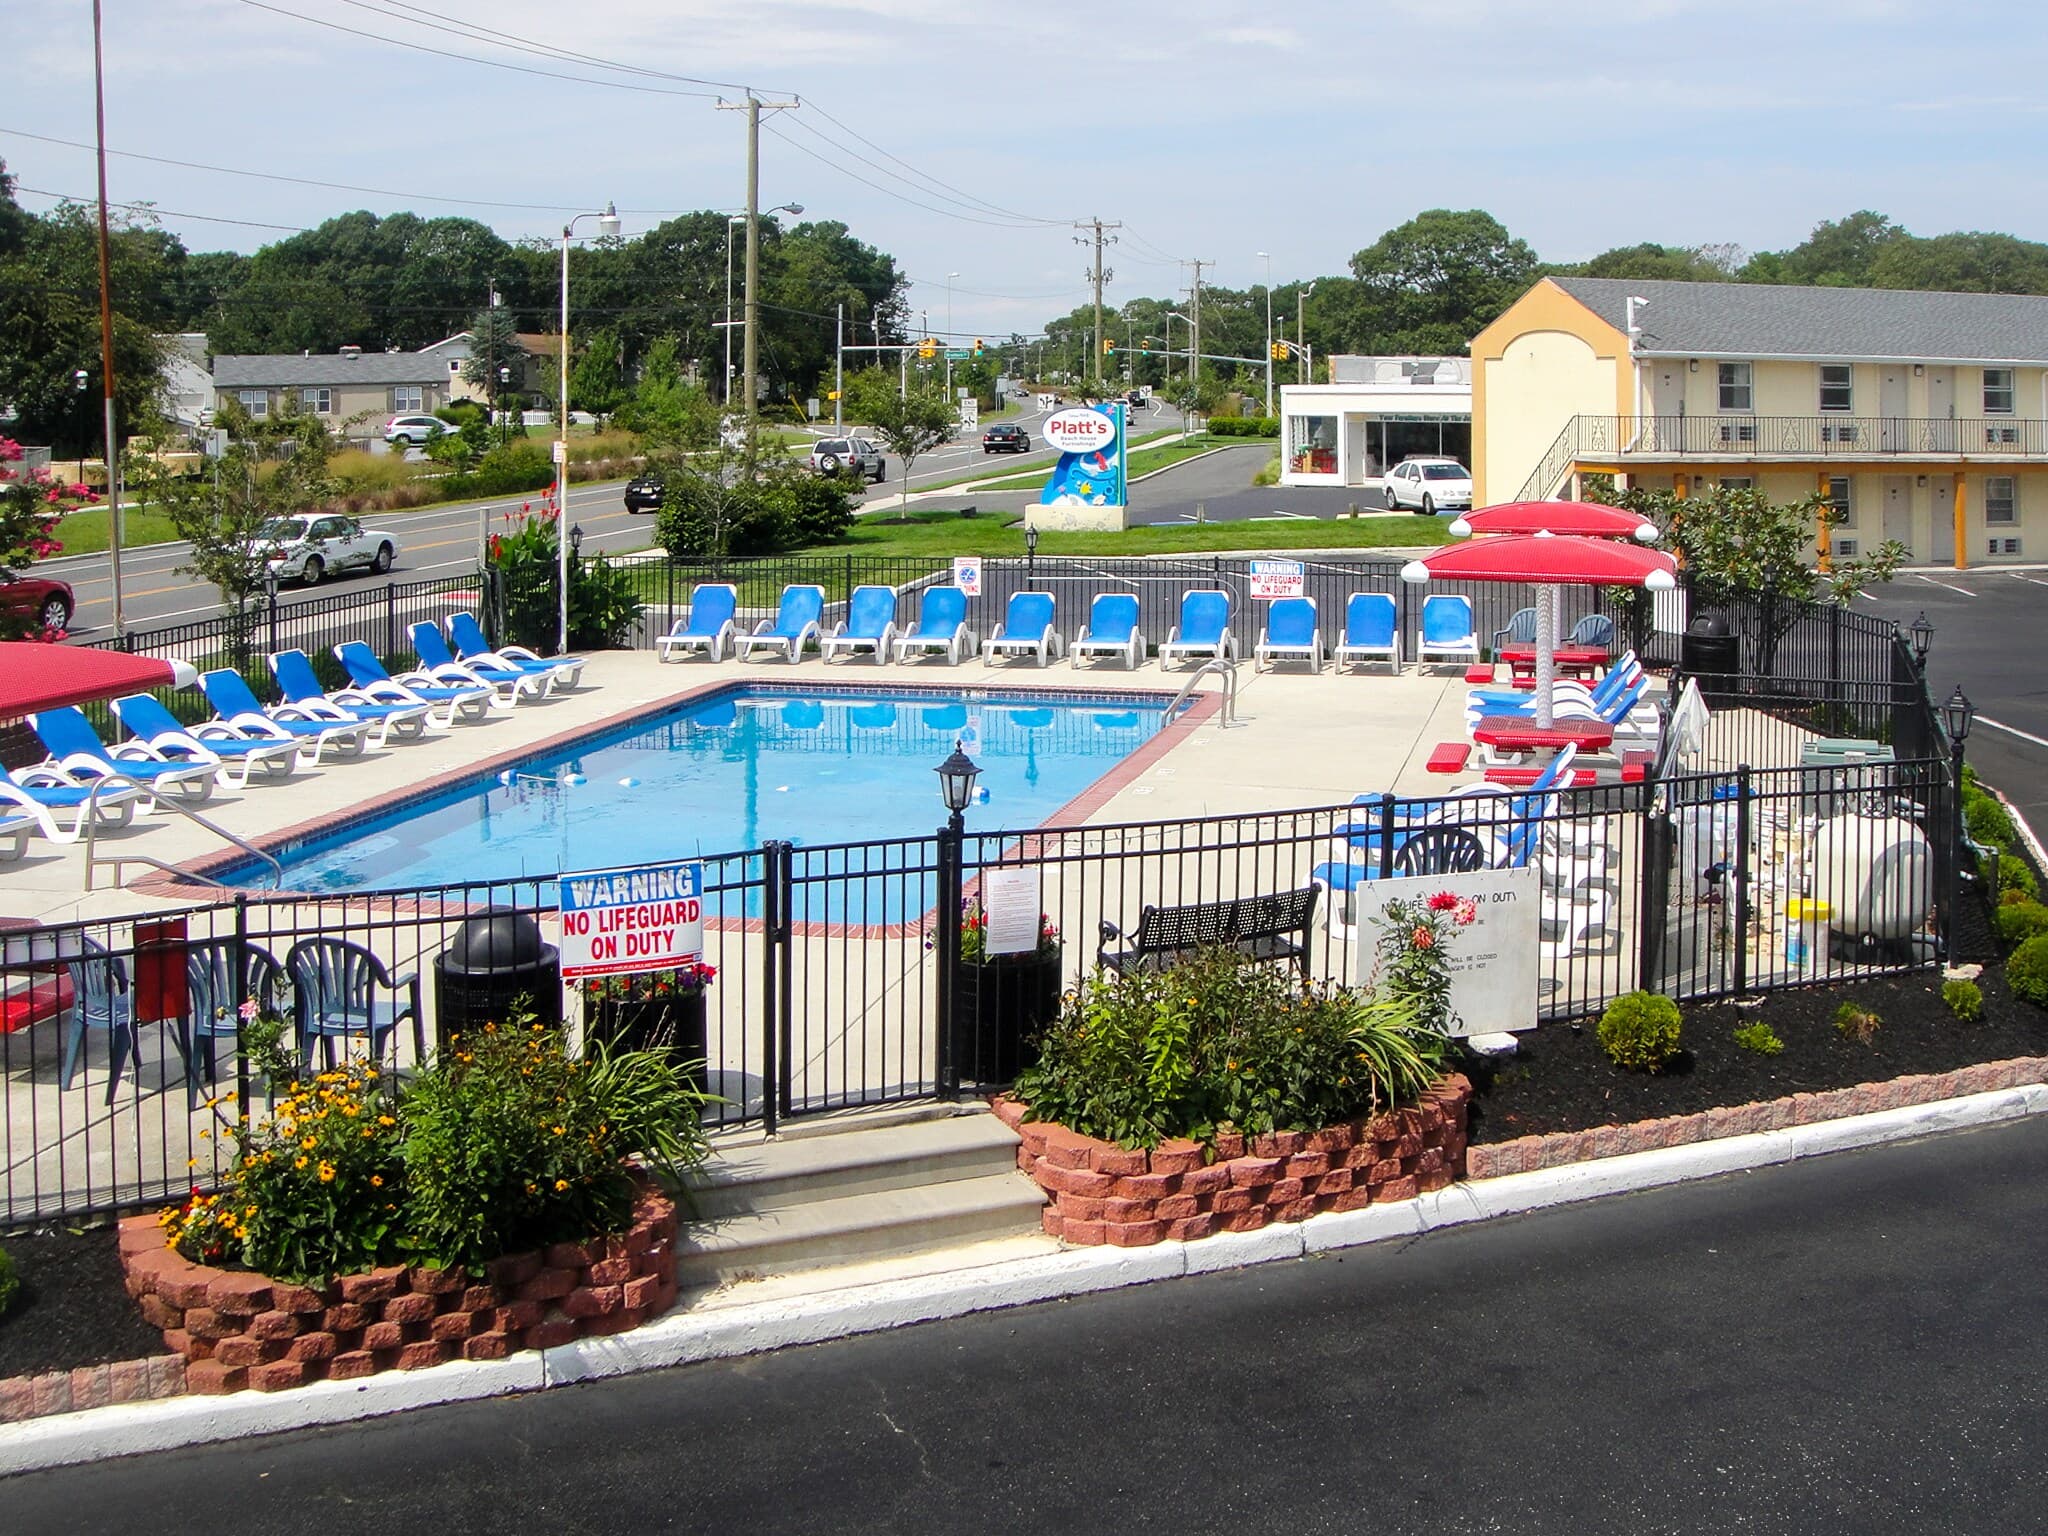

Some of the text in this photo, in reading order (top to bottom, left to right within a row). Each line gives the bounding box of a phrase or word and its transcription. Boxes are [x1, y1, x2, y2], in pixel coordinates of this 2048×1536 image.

[1051, 420, 1107, 434] Platt's
[1255, 562, 1300, 574] WARNING
[1252, 575, 1302, 585] NO LIFEGUARD
[1261, 585, 1292, 594] ON DUTY
[570, 867, 694, 908] WARNING
[1472, 893, 1487, 905] ON
[564, 899, 700, 936] NO LIFEGUARD
[591, 929, 676, 960] ON DUTY
